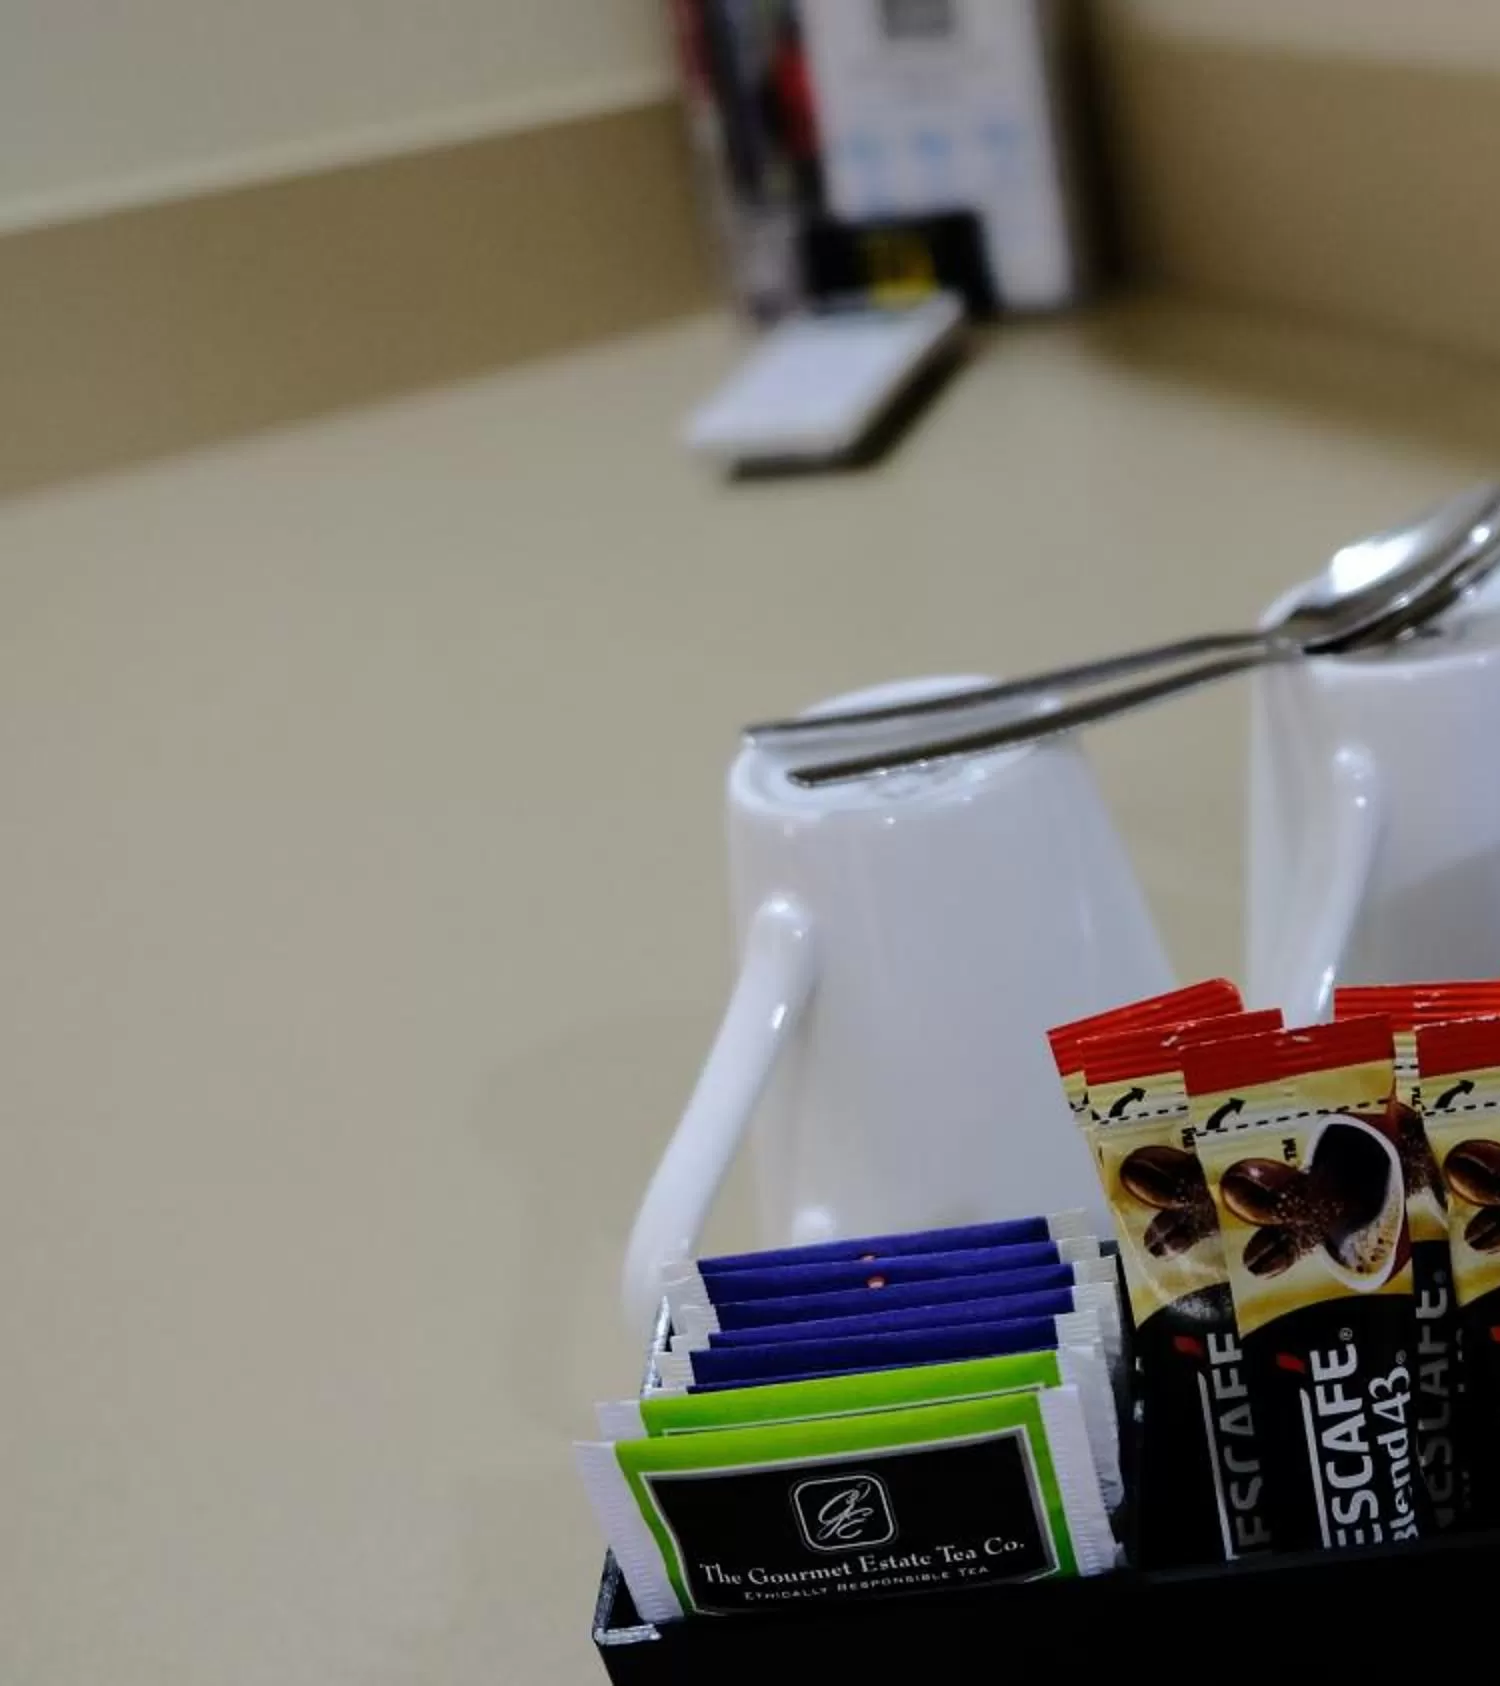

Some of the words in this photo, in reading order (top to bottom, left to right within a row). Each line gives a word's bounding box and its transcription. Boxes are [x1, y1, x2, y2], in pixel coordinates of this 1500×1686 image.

[699, 1562, 742, 1585] The
[748, 1561, 853, 1585] Gourmet
[858, 1553, 932, 1573] Estate
[936, 1544, 978, 1563] Tea
[984, 1536, 1025, 1555] Co.
[744, 1586, 828, 1601] ETHICALLY
[837, 1571, 950, 1592] RESPONSIBLE
[957, 1565, 990, 1577] TEA
